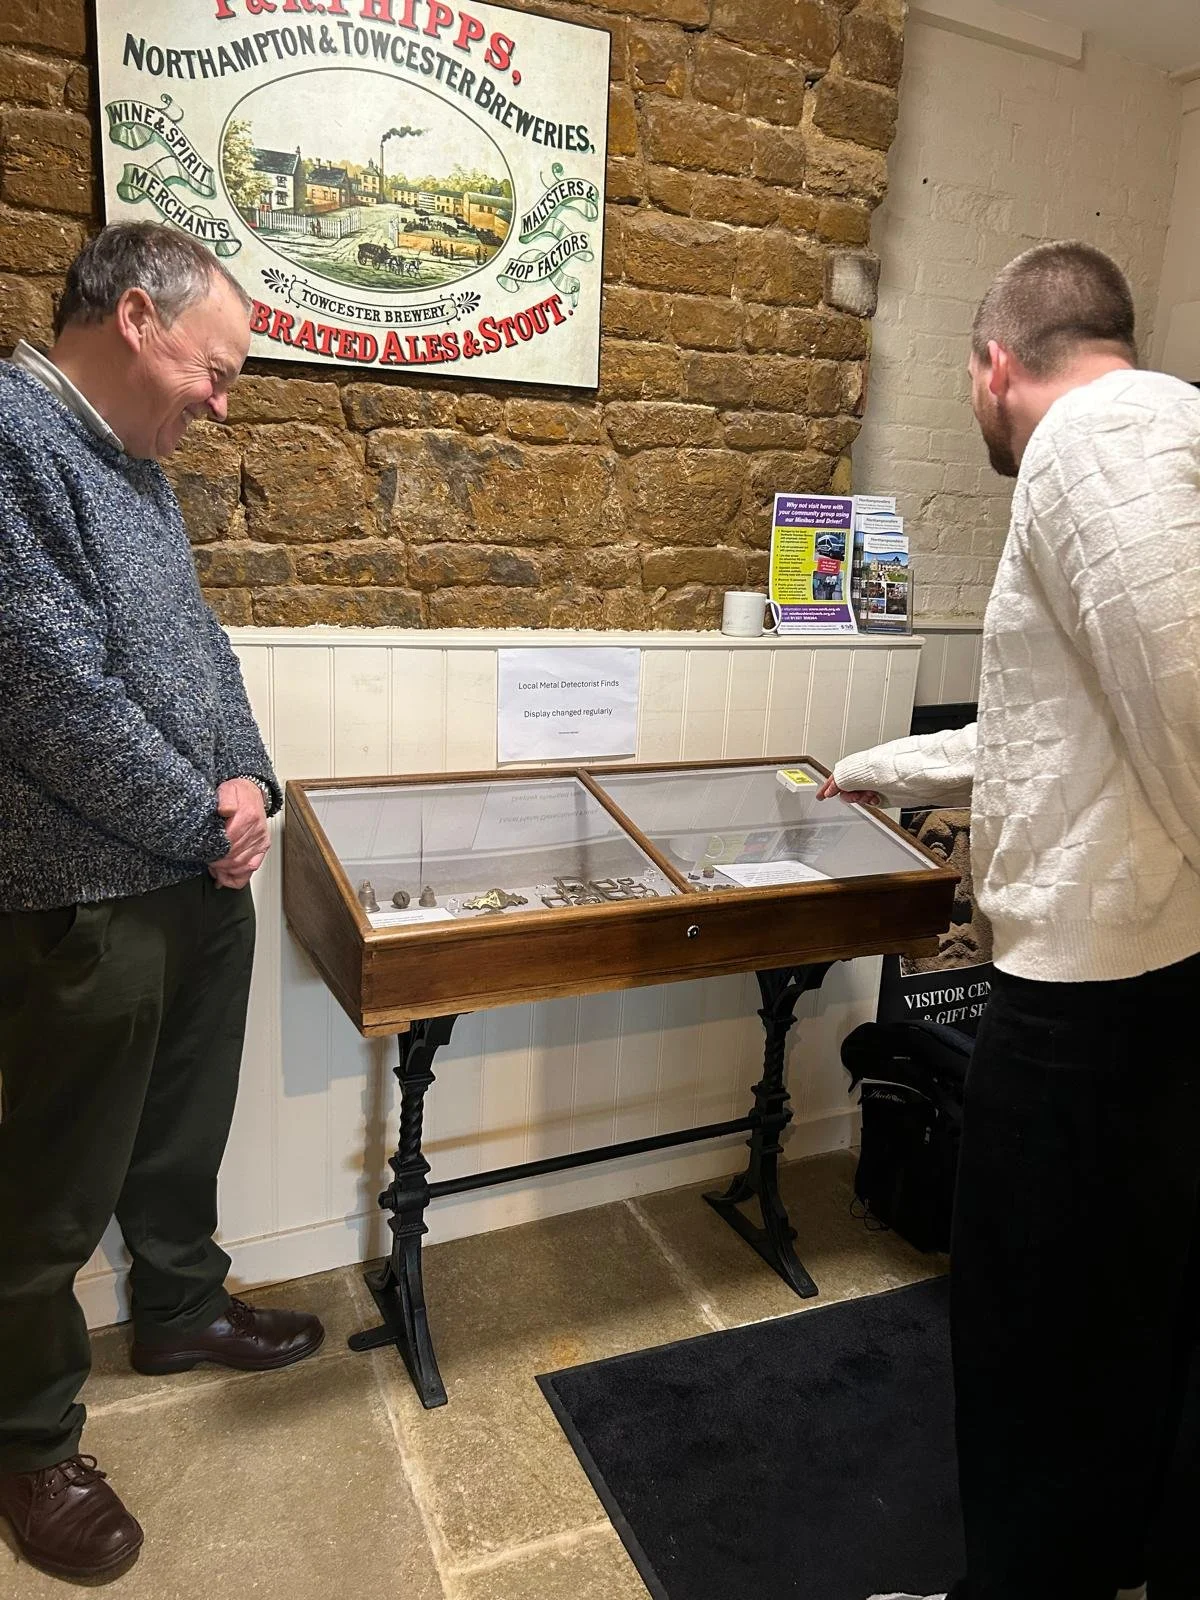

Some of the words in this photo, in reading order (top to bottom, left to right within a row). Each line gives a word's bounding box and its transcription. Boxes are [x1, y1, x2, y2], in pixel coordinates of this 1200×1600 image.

[122, 25, 316, 79] NORTHAMPTON
[319, 24, 337, 54] &
[337, 21, 476, 98] TOWCESTER
[475, 76, 596, 154] BREWERIES,
[109, 102, 156, 126] WINE
[153, 116, 166, 134] &
[165, 127, 213, 183] SPIRIT
[131, 167, 230, 239] MERCHANTS
[522, 180, 585, 234] MALTSTERS
[586, 185, 596, 202] &
[505, 261, 534, 280] HOP
[538, 234, 589, 278] FACTORS
[302, 288, 381, 323] TOWCESTER
[385, 303, 449, 322] BREWERY.
[250, 299, 378, 363] BRATED
[379, 330, 460, 366] ALES
[462, 330, 482, 359] &
[786, 501, 798, 509] Why
[518, 682, 538, 690] Local
[540, 681, 560, 689] Metal
[561, 680, 599, 689] Detectorist
[601, 679, 619, 688] Finds
[524, 710, 550, 720] Display
[552, 708, 581, 718] changed
[583, 707, 613, 717] regularly
[903, 986, 965, 1010] VISITOR
[968, 981, 992, 999] CEN
[936, 1006, 968, 1025] GIFT
[969, 1003, 988, 1019] SH
